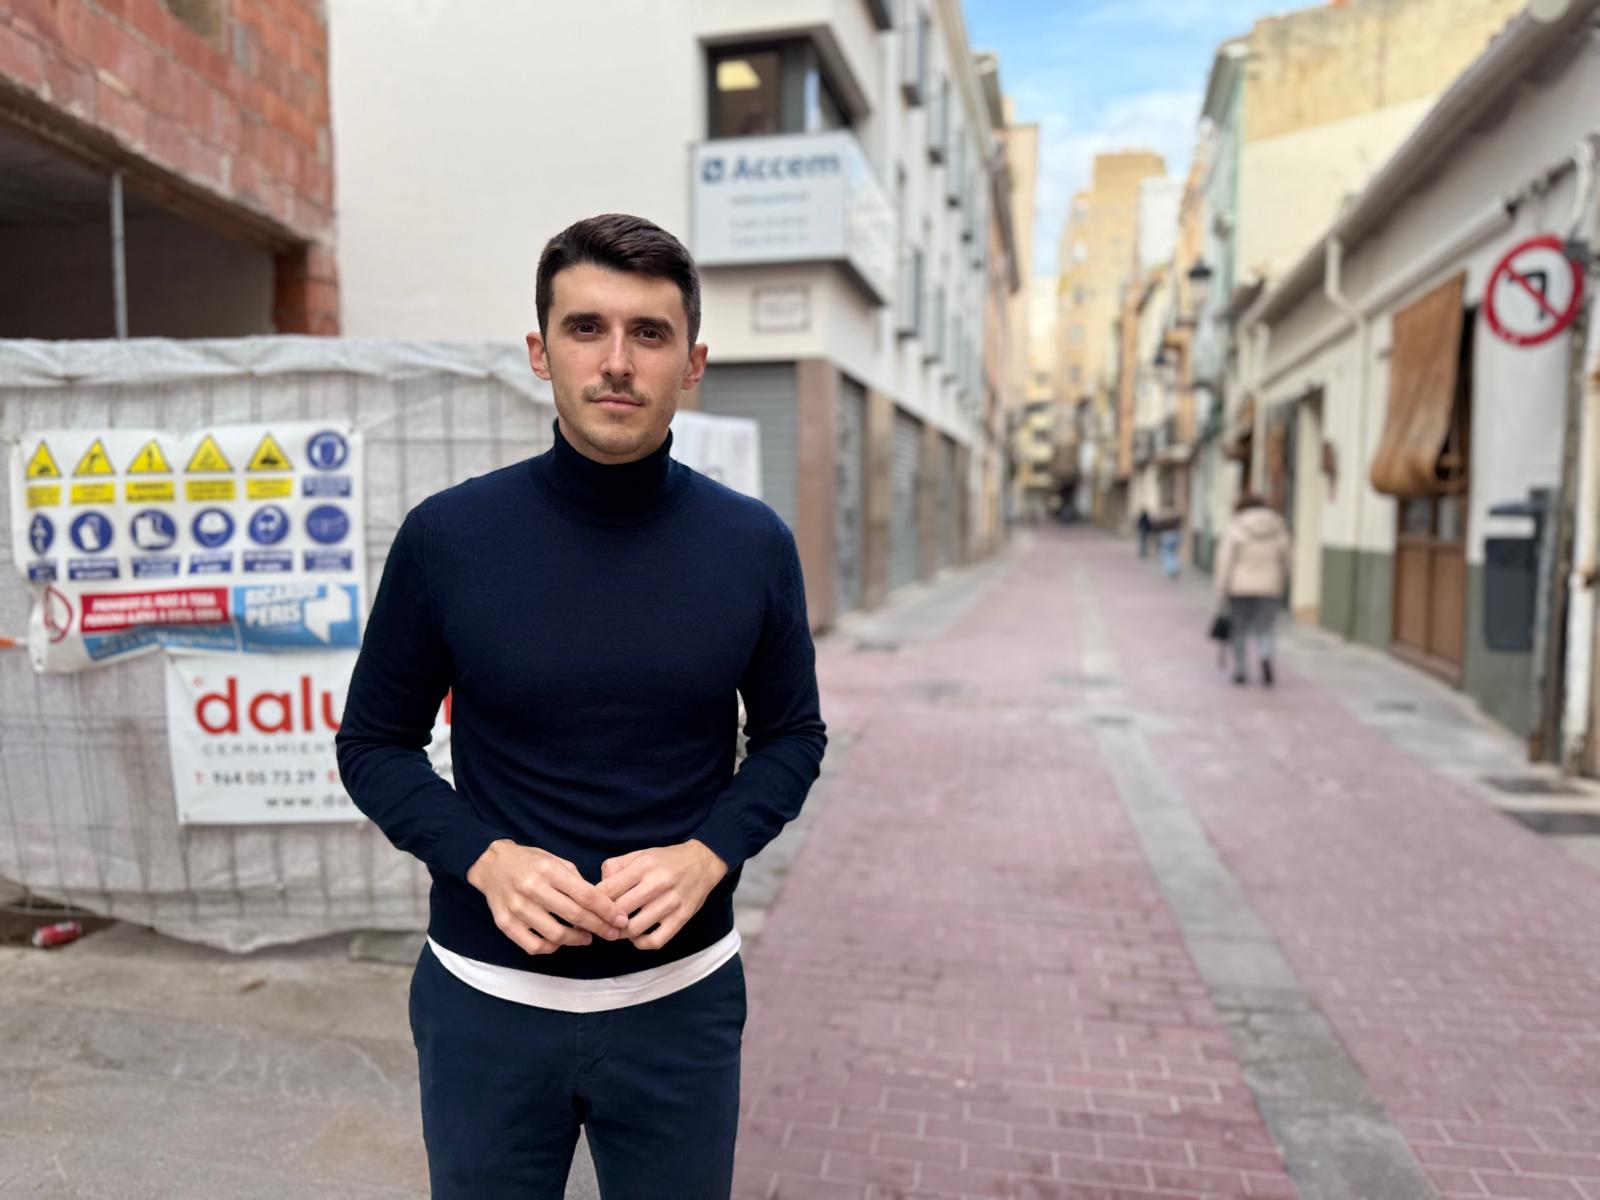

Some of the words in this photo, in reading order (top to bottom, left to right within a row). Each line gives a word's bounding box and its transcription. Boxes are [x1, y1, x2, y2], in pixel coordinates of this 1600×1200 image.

[731, 154, 841, 181] Accem
[246, 602, 302, 627] PERIS
[195, 674, 341, 735] dalu
